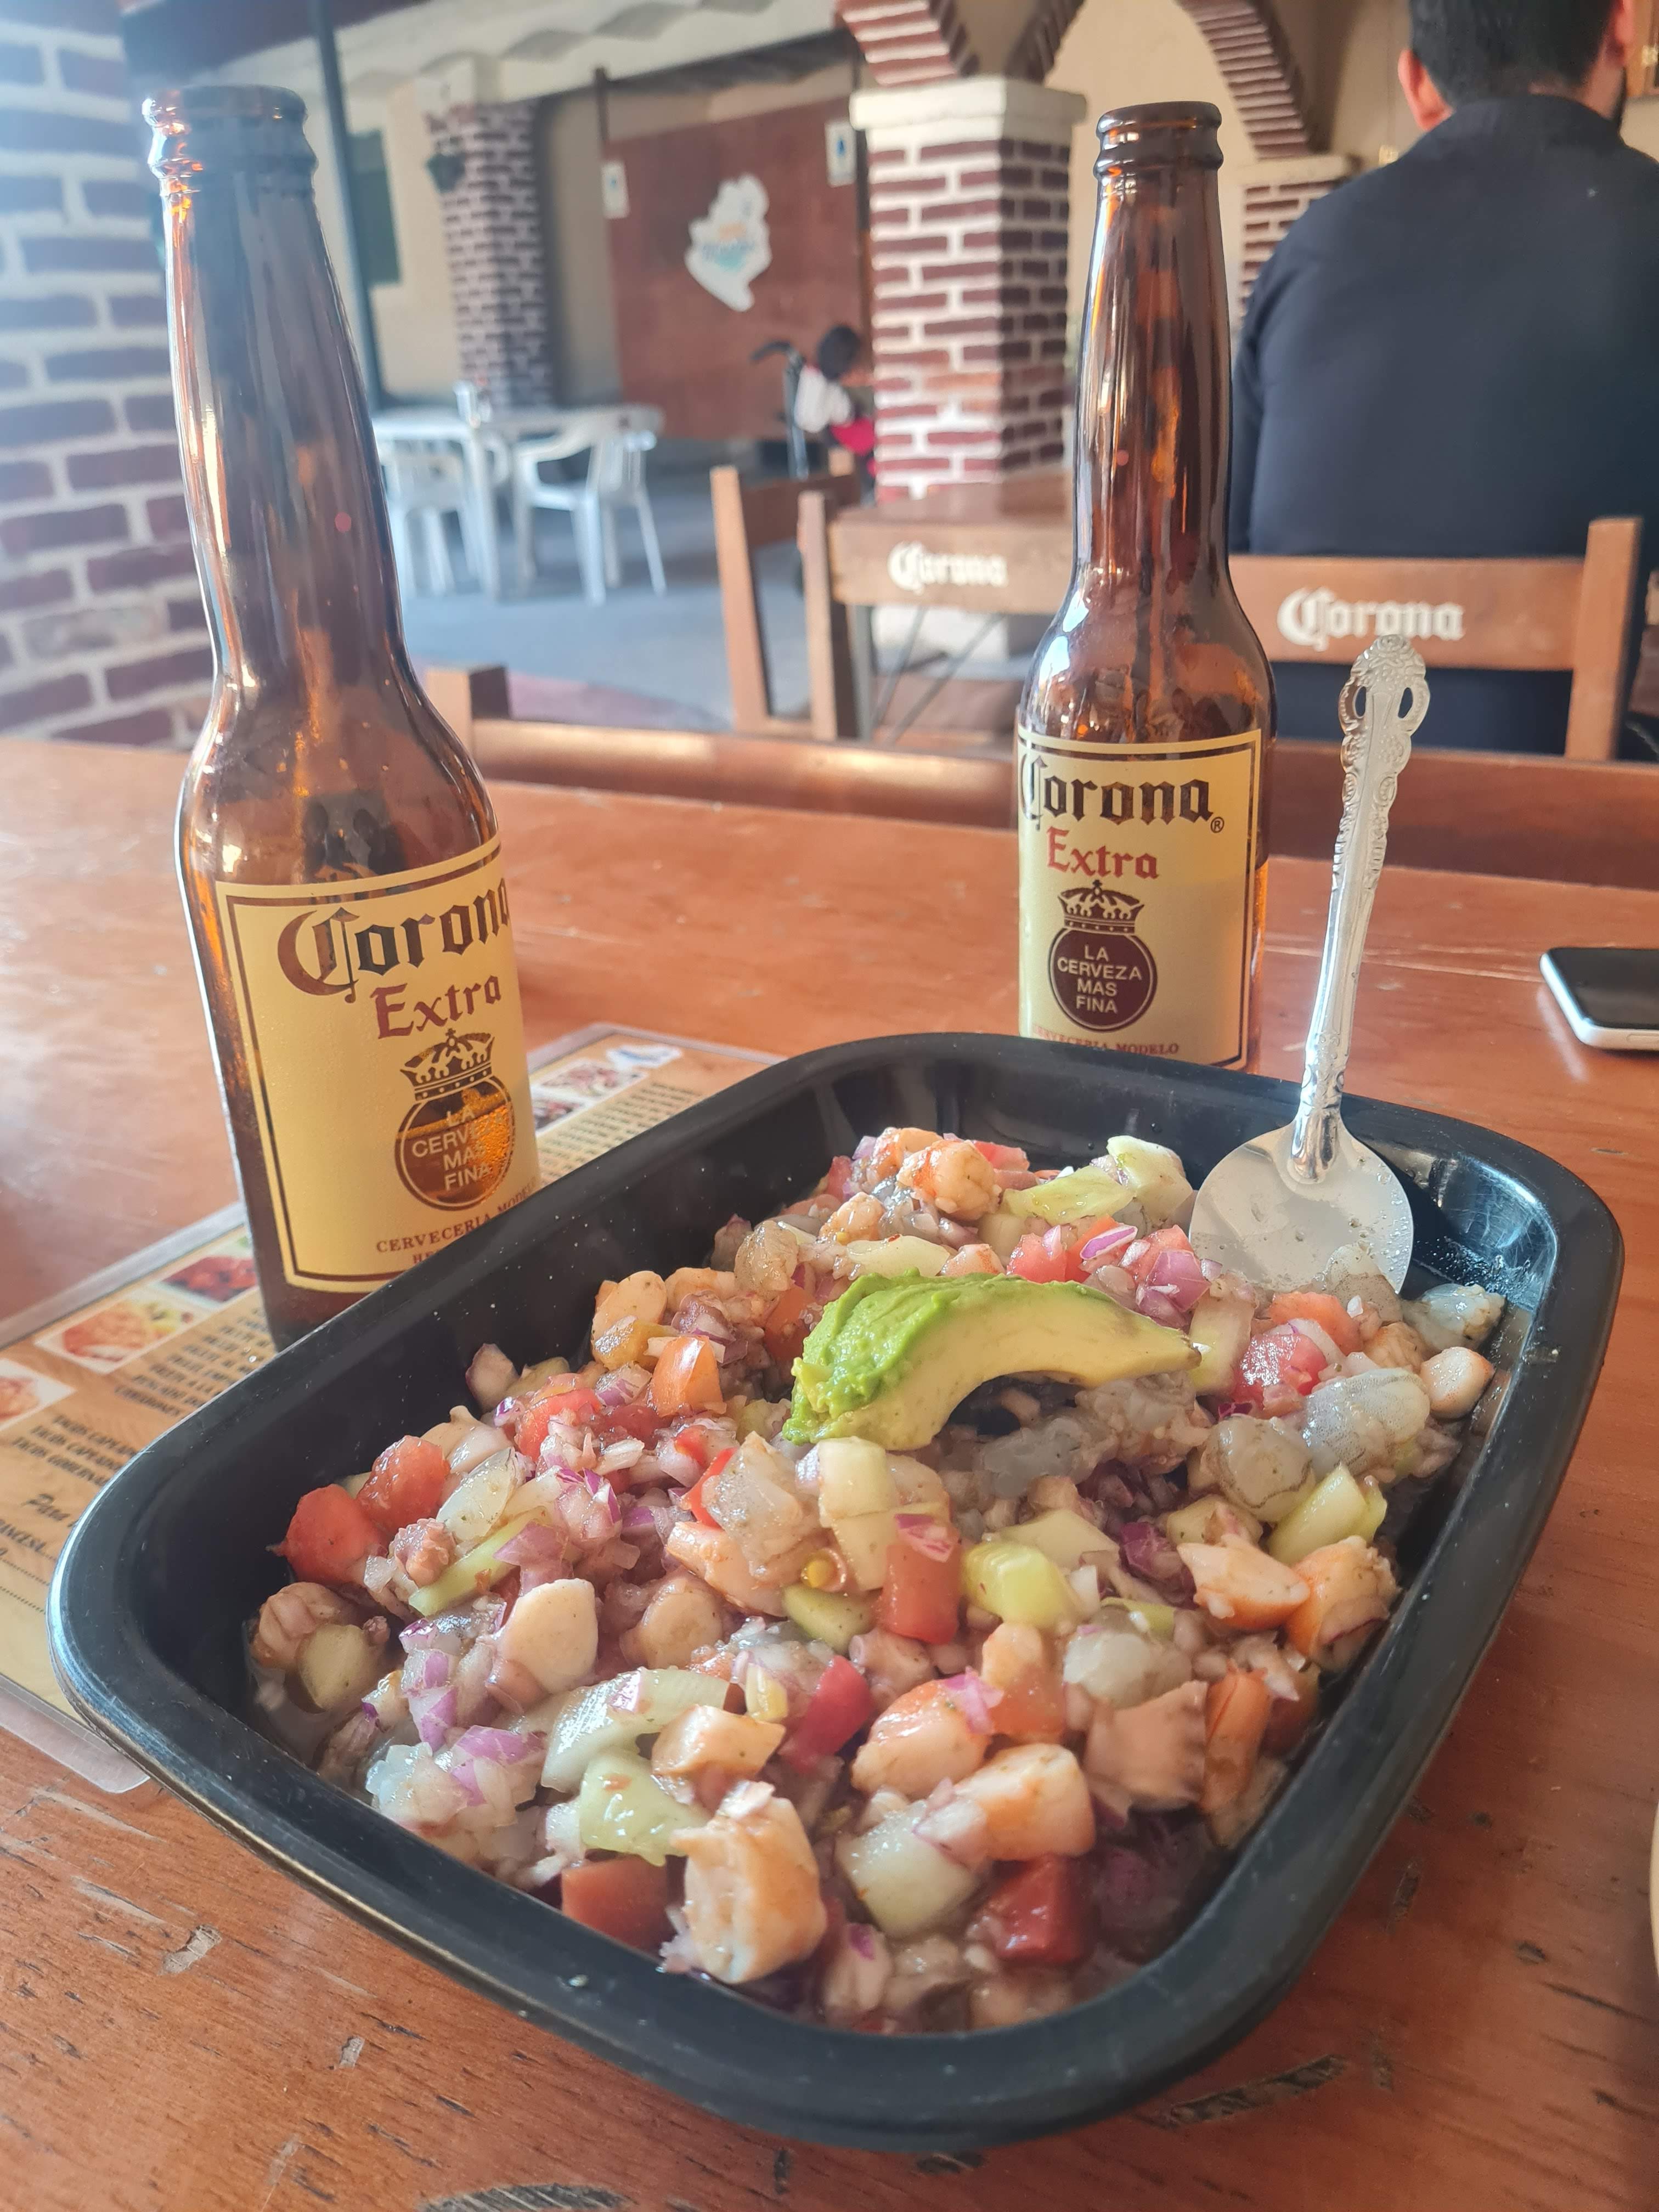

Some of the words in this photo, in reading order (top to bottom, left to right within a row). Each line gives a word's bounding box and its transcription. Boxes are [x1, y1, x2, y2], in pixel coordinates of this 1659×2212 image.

[1277, 587, 1466, 652] Corona
[1021, 754, 1213, 831] Corona
[1047, 826, 1159, 879] Extra
[278, 878, 510, 1003] Corona
[1084, 944, 1109, 962] LA
[1057, 957, 1142, 980] CERVEZA
[1077, 978, 1118, 997] MAS
[370, 975, 501, 1040] Extra
[1076, 995, 1118, 1013] FINA
[446, 1104, 476, 1127] LA
[443, 1140, 486, 1171] MAS
[444, 1163, 490, 1191] FINA
[376, 1212, 492, 1254] CERVECERIA
